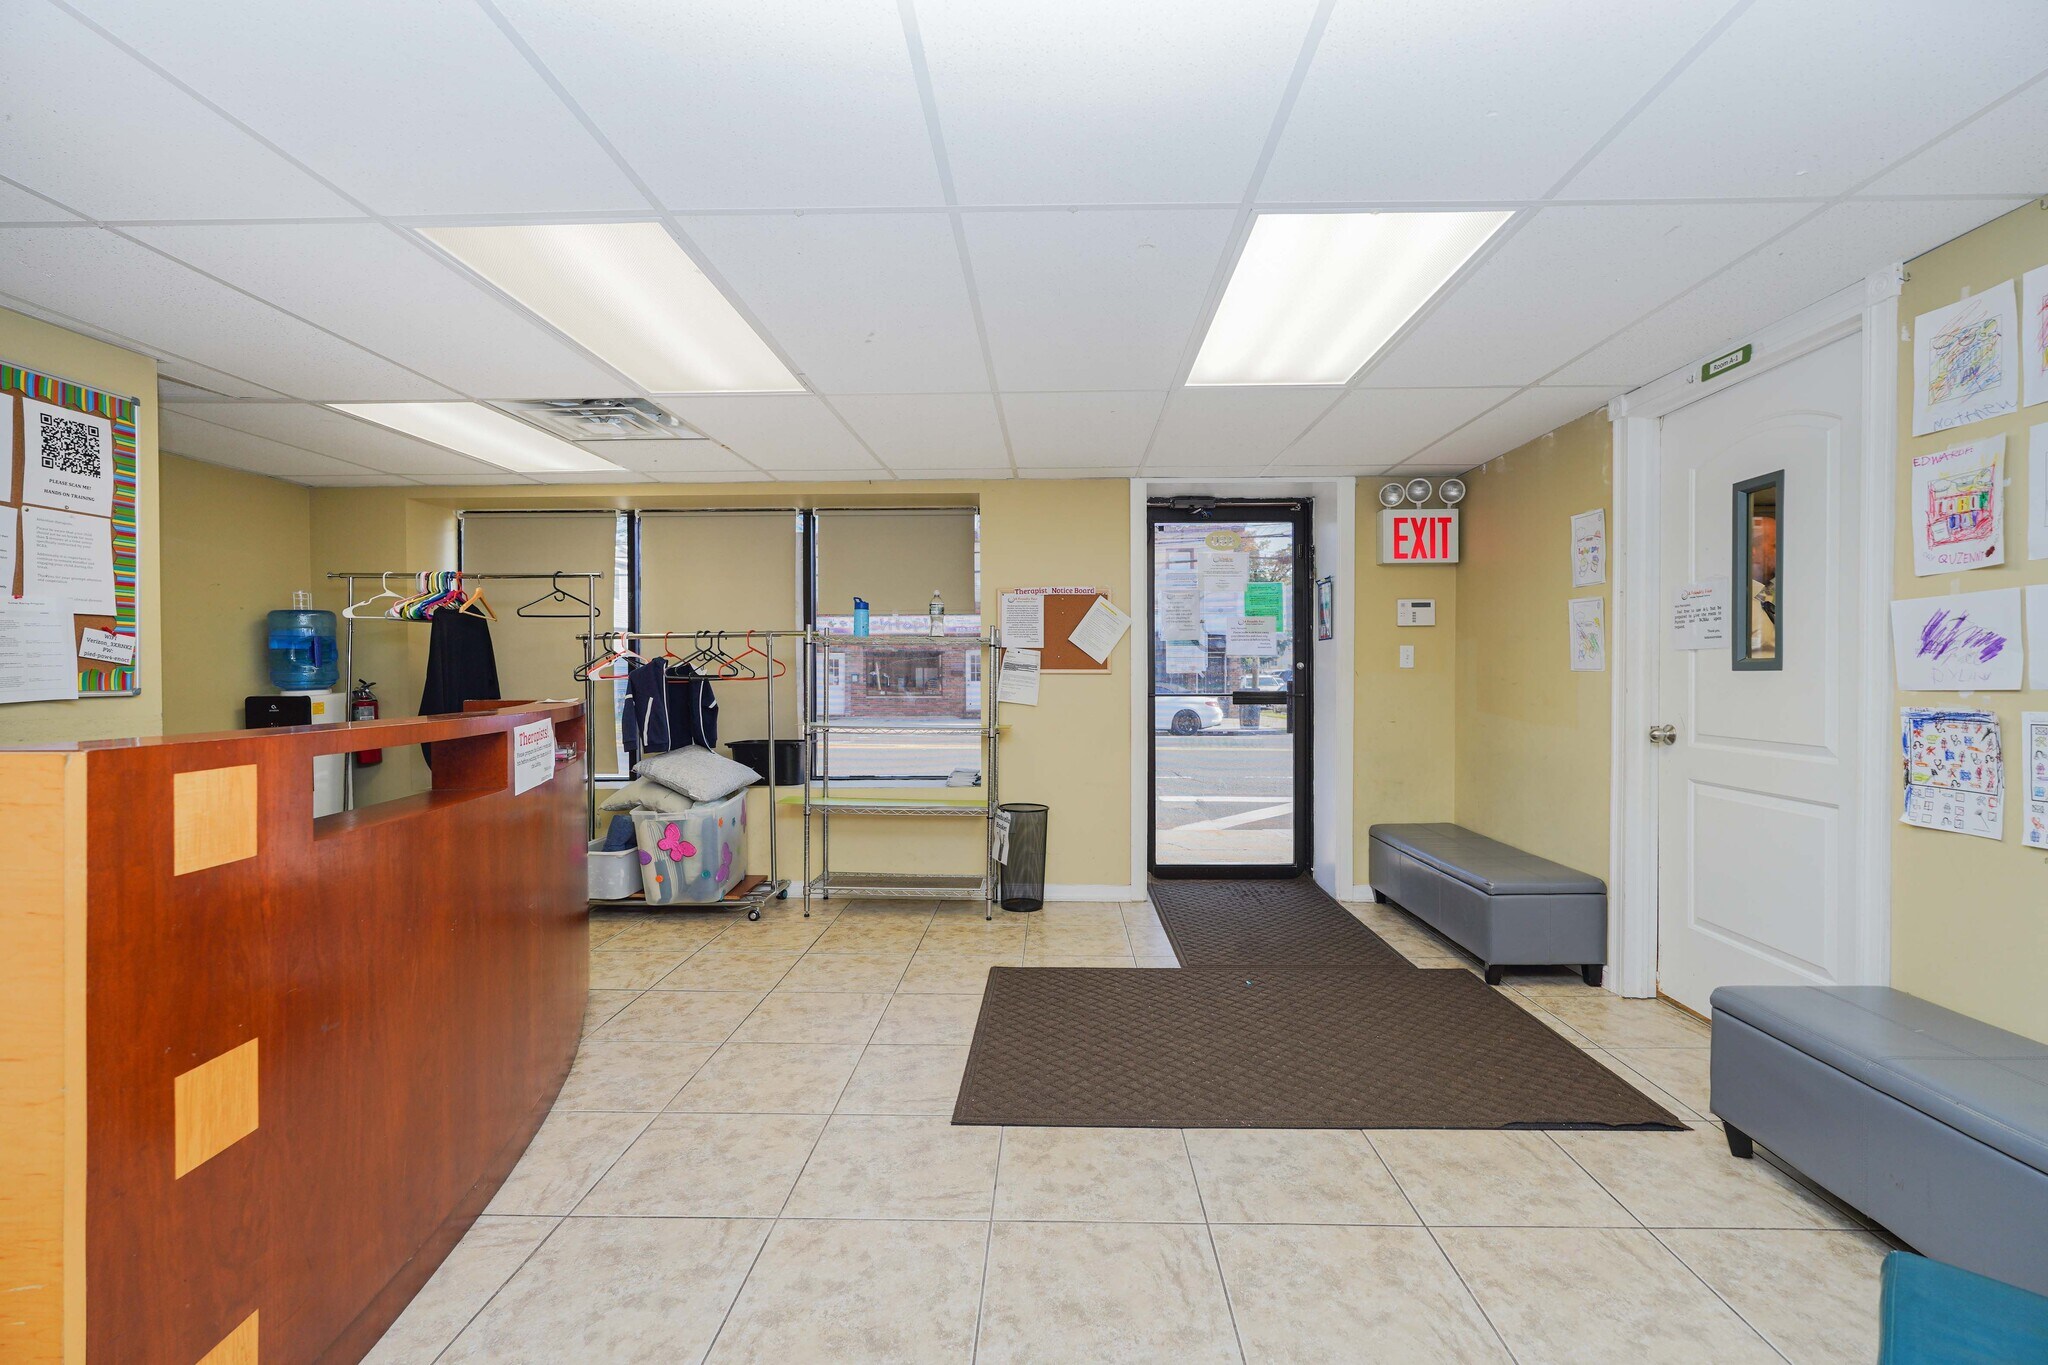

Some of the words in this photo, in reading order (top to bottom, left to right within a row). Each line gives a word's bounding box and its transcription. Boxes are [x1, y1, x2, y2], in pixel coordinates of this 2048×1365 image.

[1714, 361, 1728, 370] Room
[1730, 354, 1738, 364] A-1
[70, 494, 94, 502] TRAINING
[1393, 517, 1452, 559] EXIT
